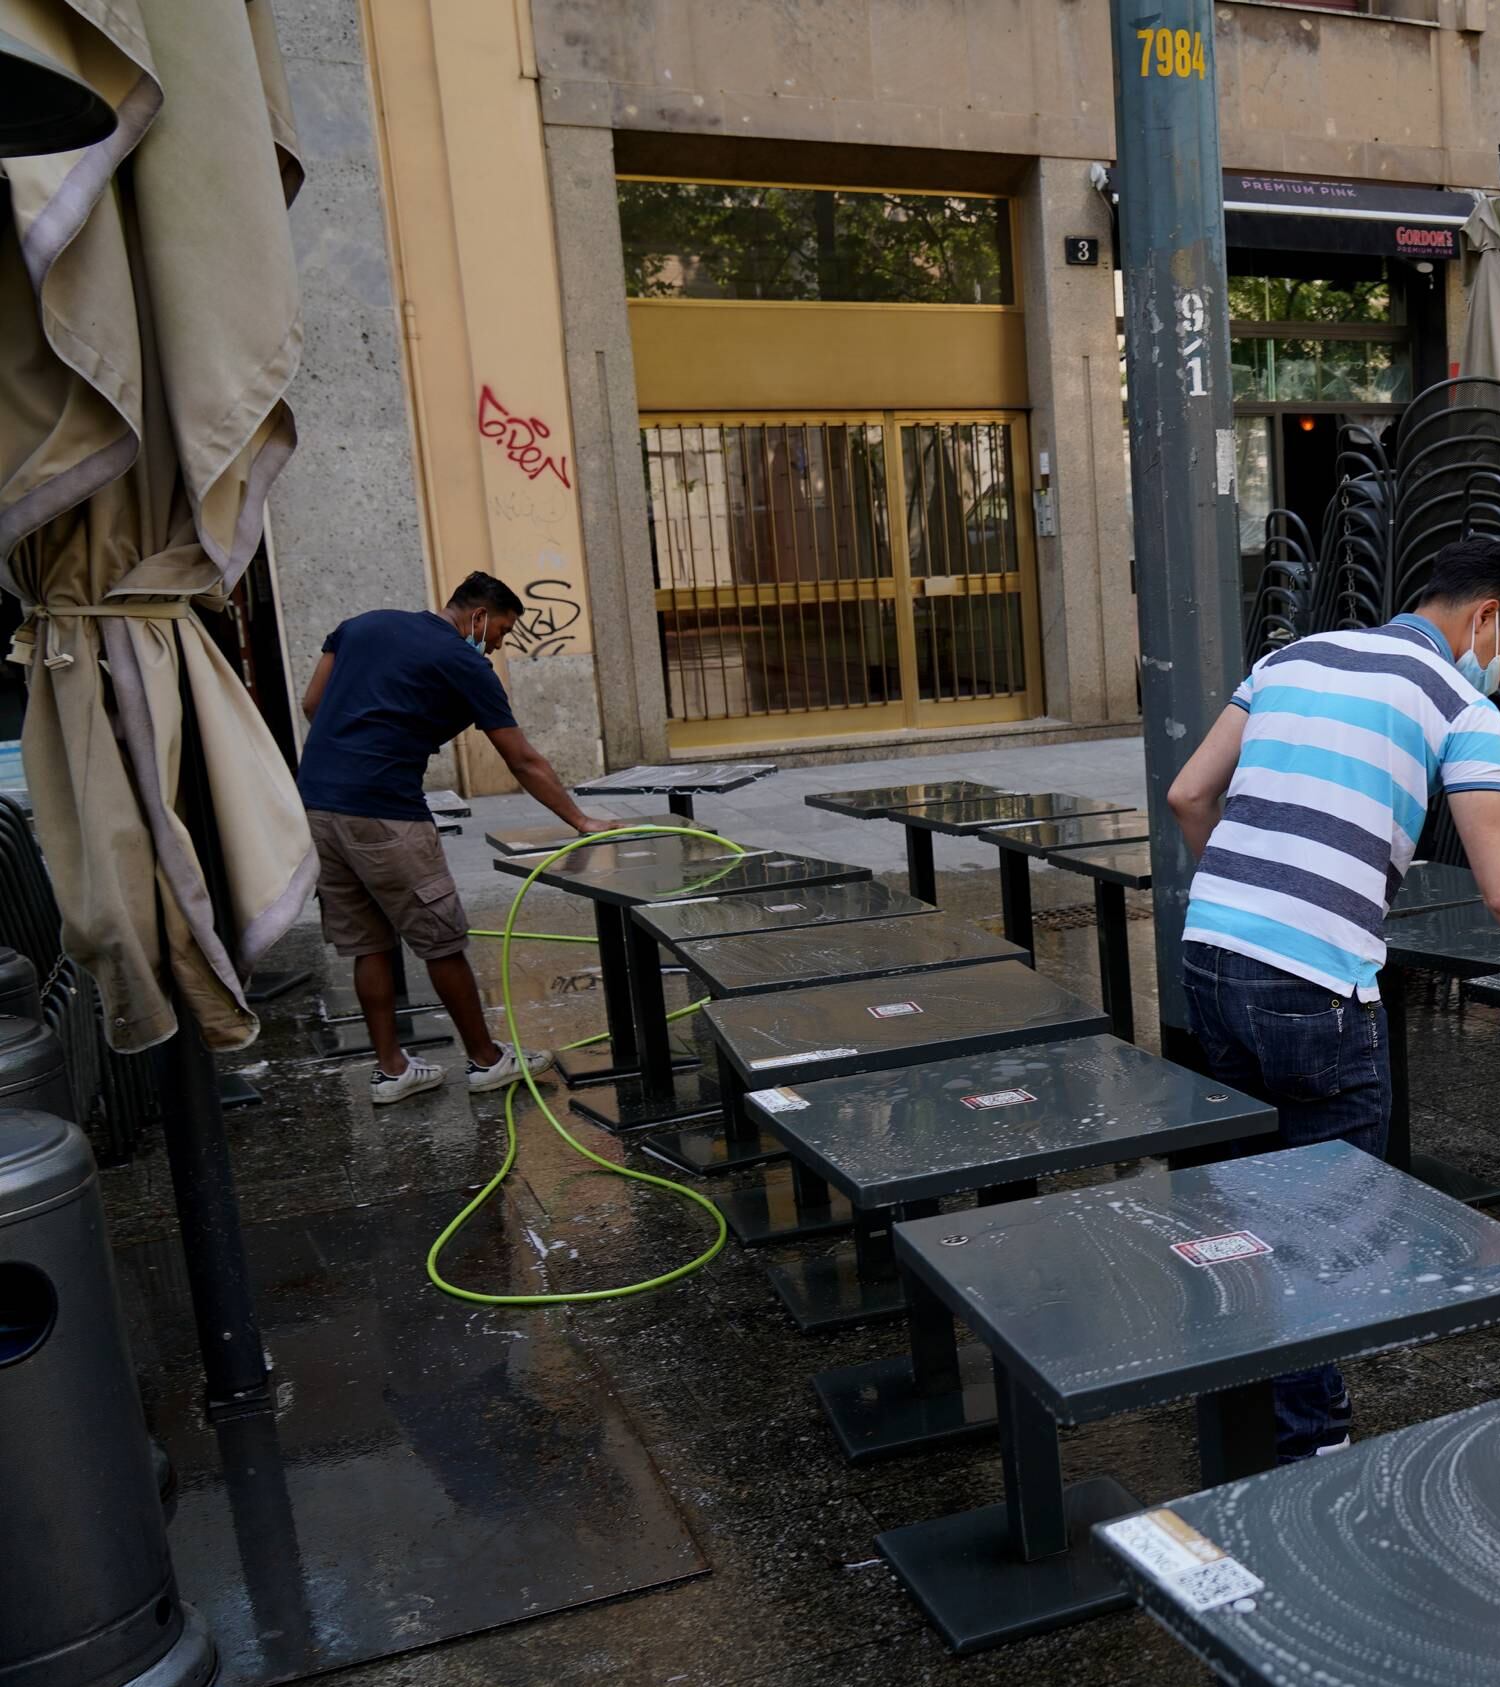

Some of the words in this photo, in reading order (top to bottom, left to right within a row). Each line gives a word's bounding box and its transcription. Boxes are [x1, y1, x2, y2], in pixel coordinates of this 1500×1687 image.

[1136, 28, 1206, 81] 7984
[1241, 180, 1315, 195] PREMIUM
[1320, 186, 1358, 198] PINK
[1077, 241, 1090, 261] 3
